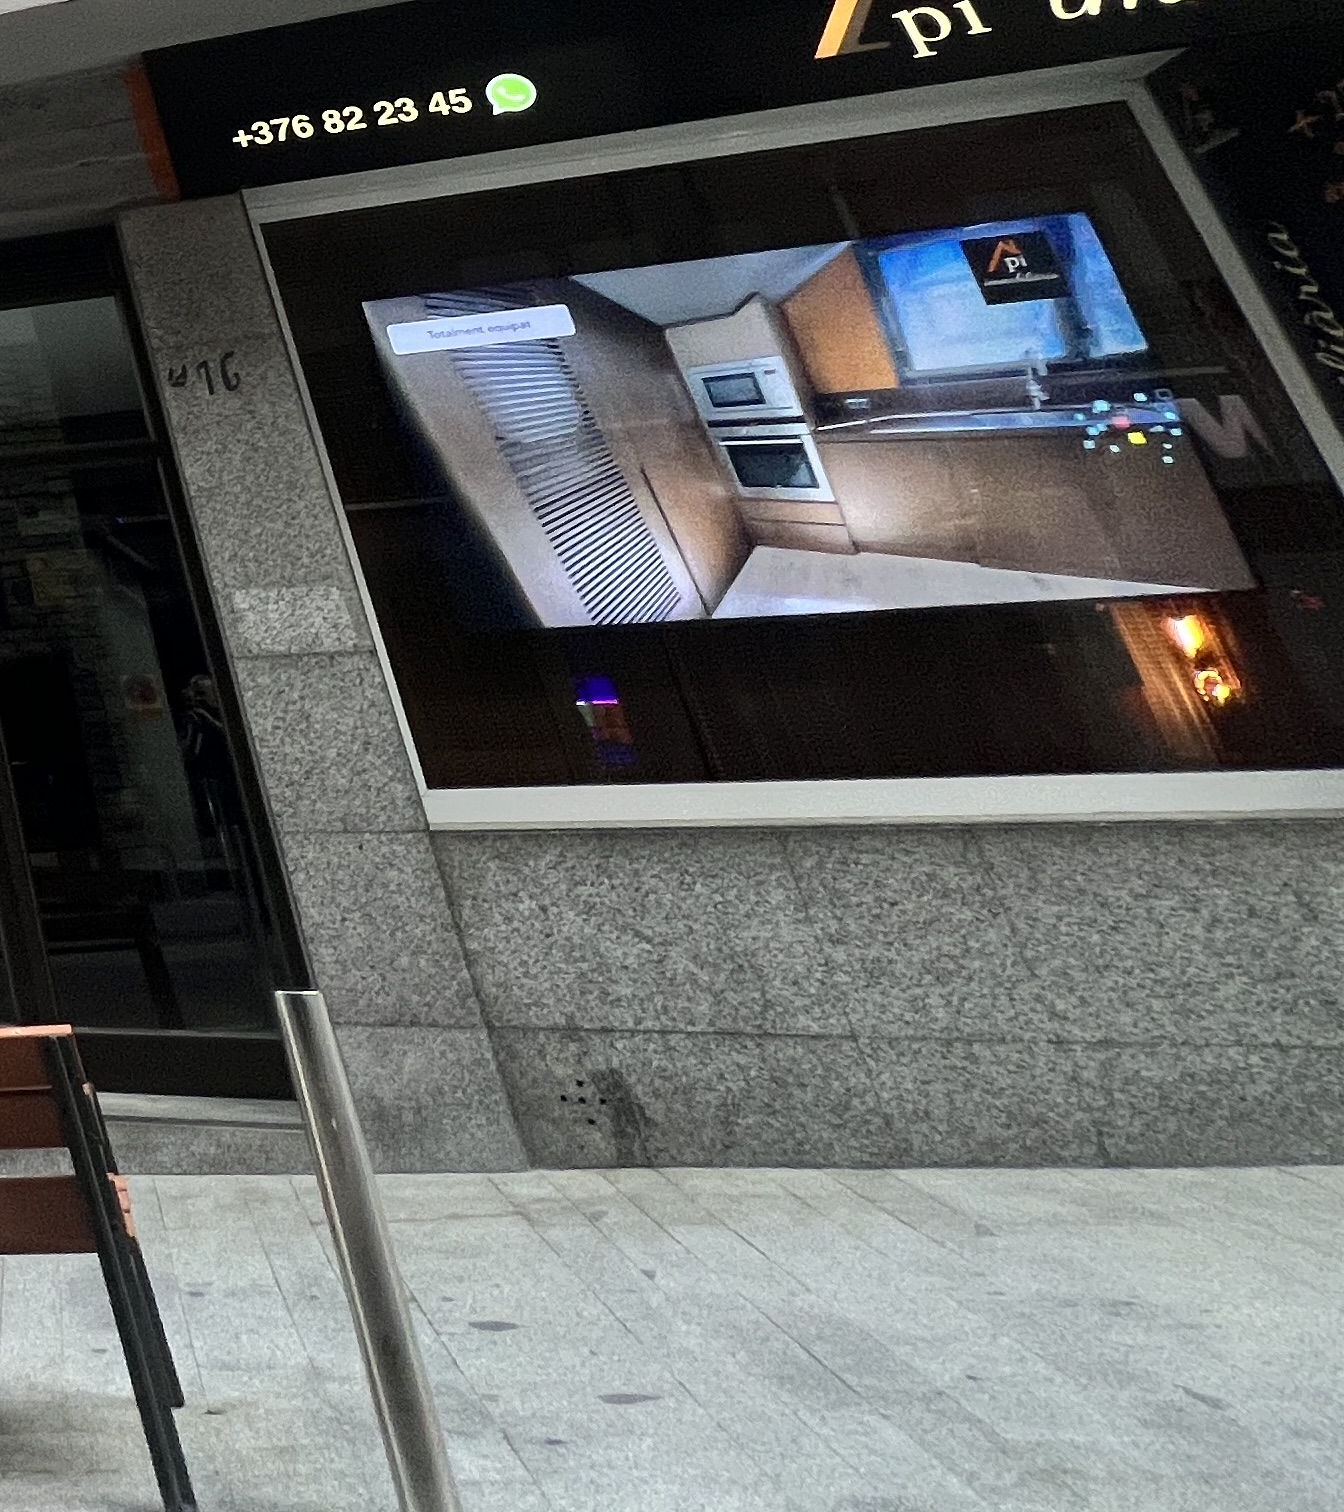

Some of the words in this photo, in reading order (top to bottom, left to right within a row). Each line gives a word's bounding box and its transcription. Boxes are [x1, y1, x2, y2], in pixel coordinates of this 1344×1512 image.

[232, 114, 315, 148] +376
[321, 105, 368, 134] 82
[373, 96, 419, 126] 23
[428, 88, 473, 116] 45
